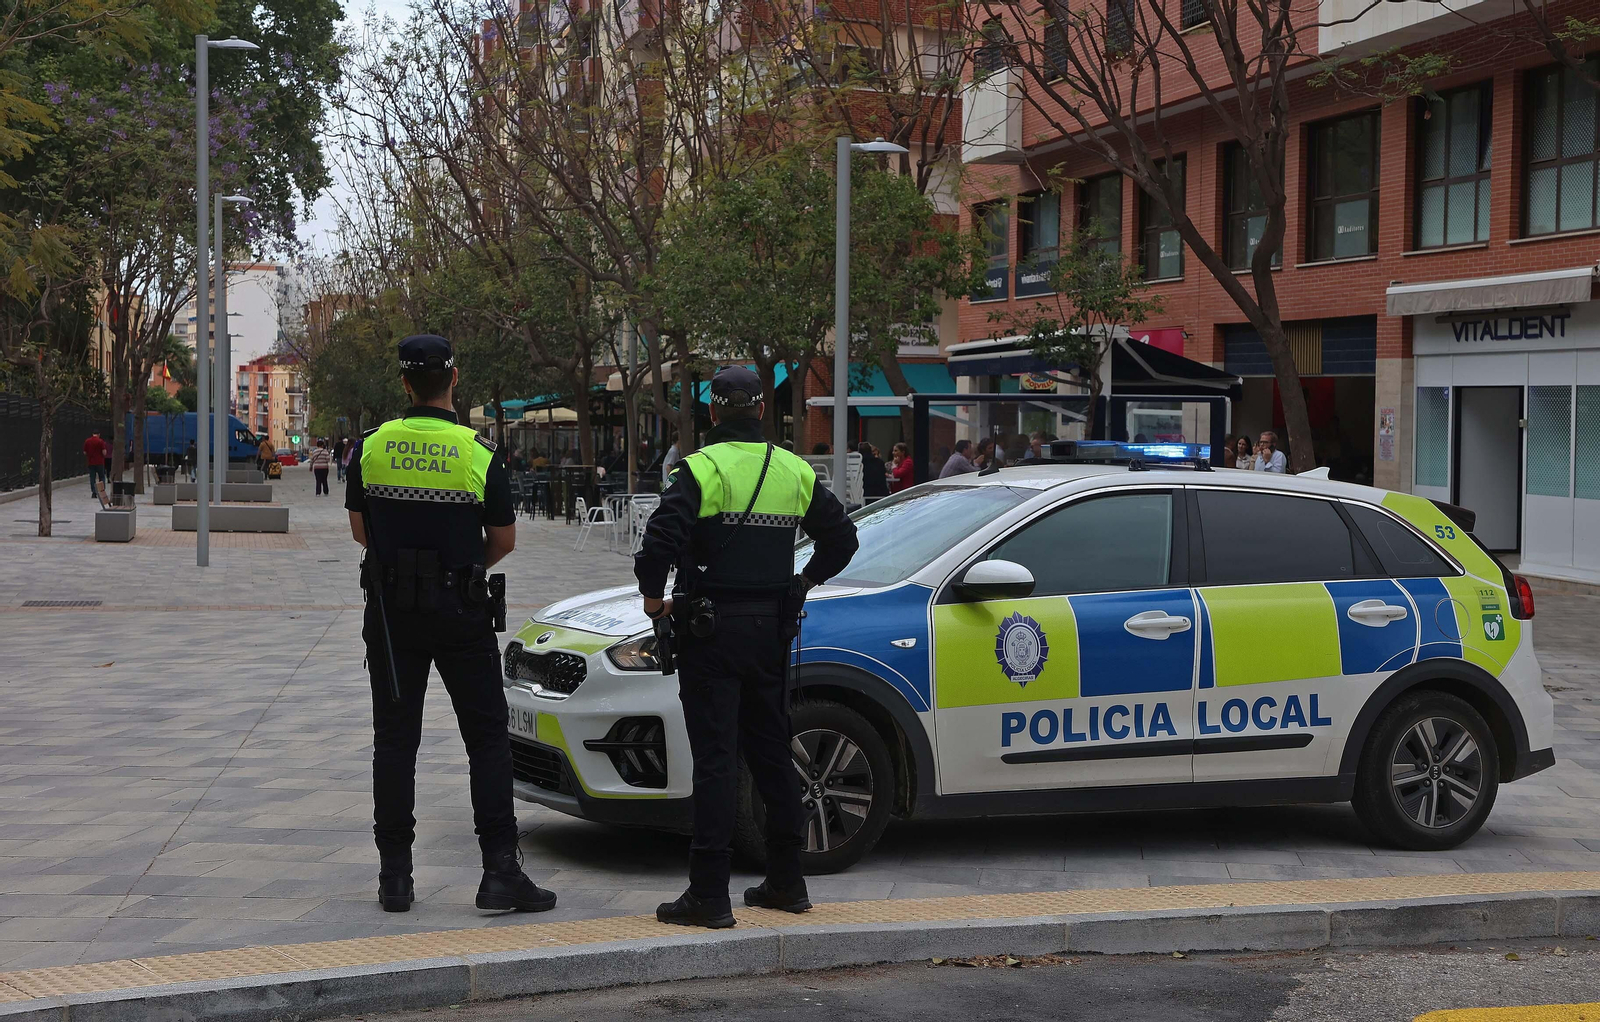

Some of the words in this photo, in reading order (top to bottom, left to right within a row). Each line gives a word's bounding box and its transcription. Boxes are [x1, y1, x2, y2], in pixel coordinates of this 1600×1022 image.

[1451, 315, 1571, 343] VITALDENT
[1025, 379, 1054, 389] POLVILLO
[385, 441, 460, 458] POLICIA
[390, 456, 451, 473] LOCAL
[1435, 525, 1456, 540] 53
[517, 710, 533, 734] LSM
[1001, 703, 1178, 747] POLICIA
[1198, 693, 1332, 735] LOCAL
